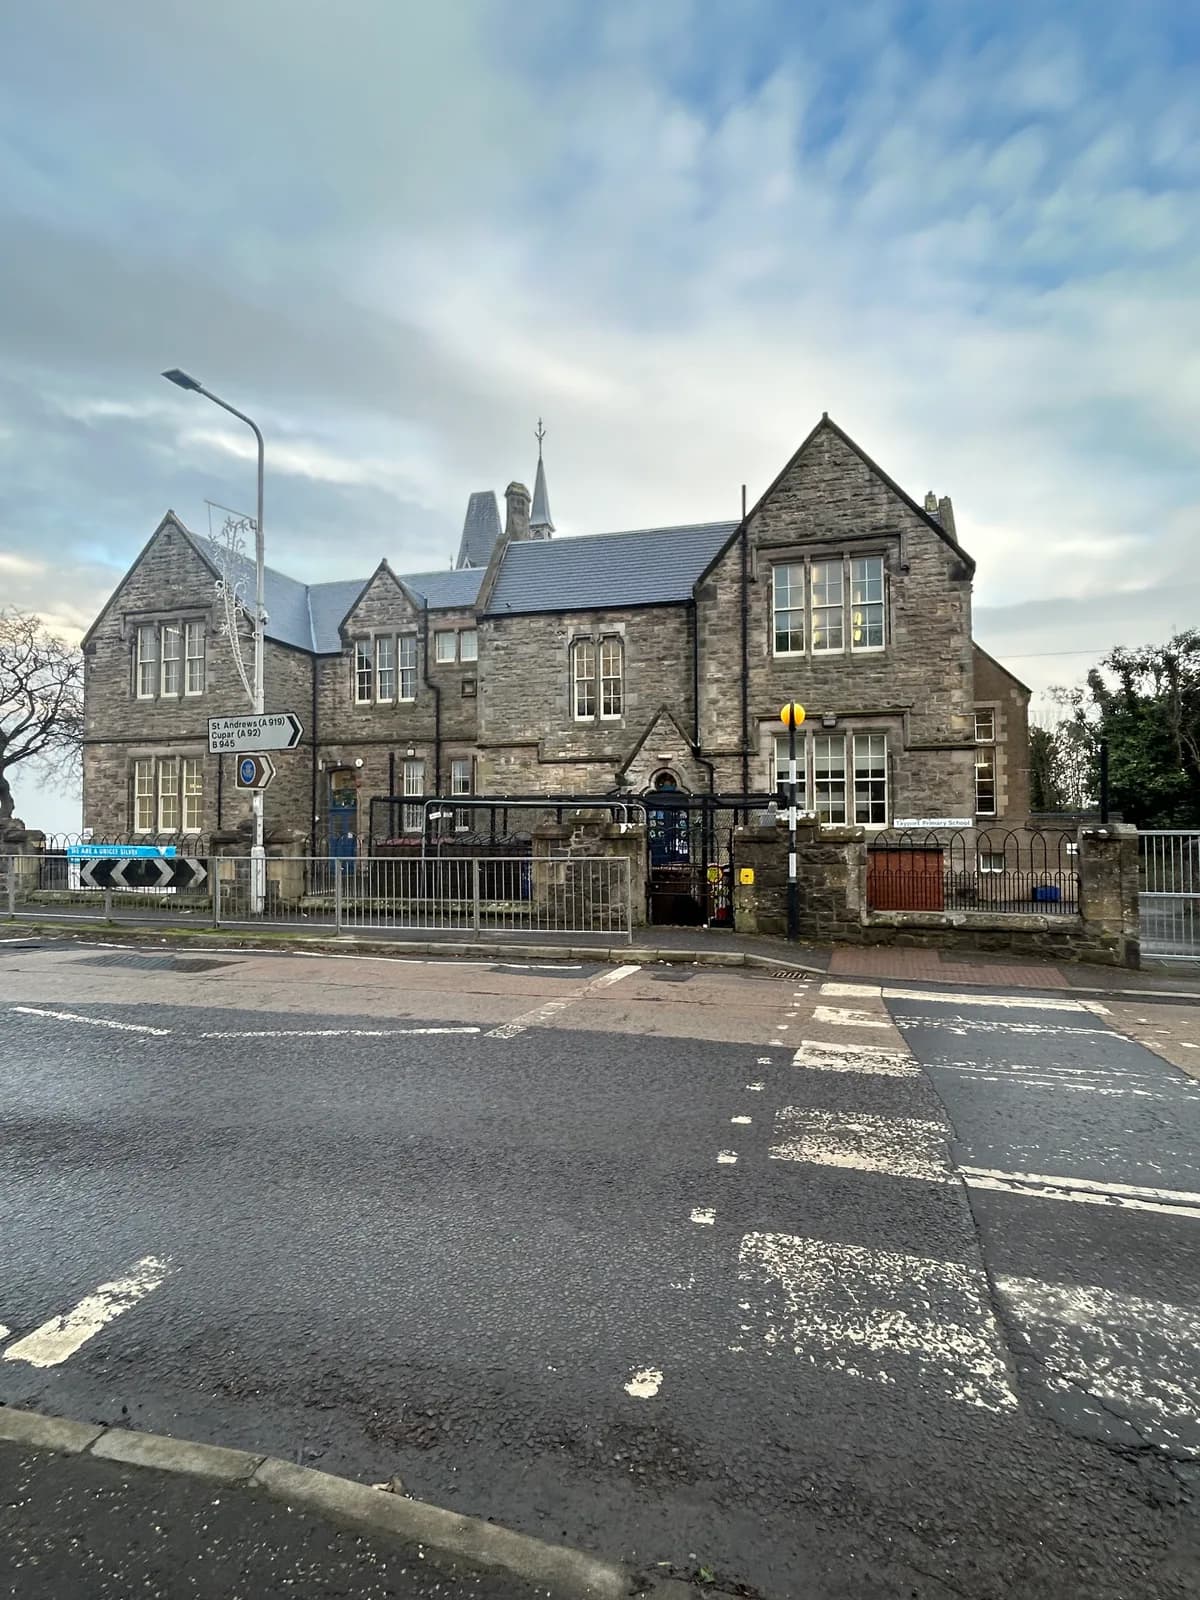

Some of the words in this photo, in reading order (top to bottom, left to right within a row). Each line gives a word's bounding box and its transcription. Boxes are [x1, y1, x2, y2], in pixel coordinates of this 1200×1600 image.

[211, 722, 220, 730] St
[223, 720, 257, 729] Andrews
[211, 732, 234, 740] Cupar
